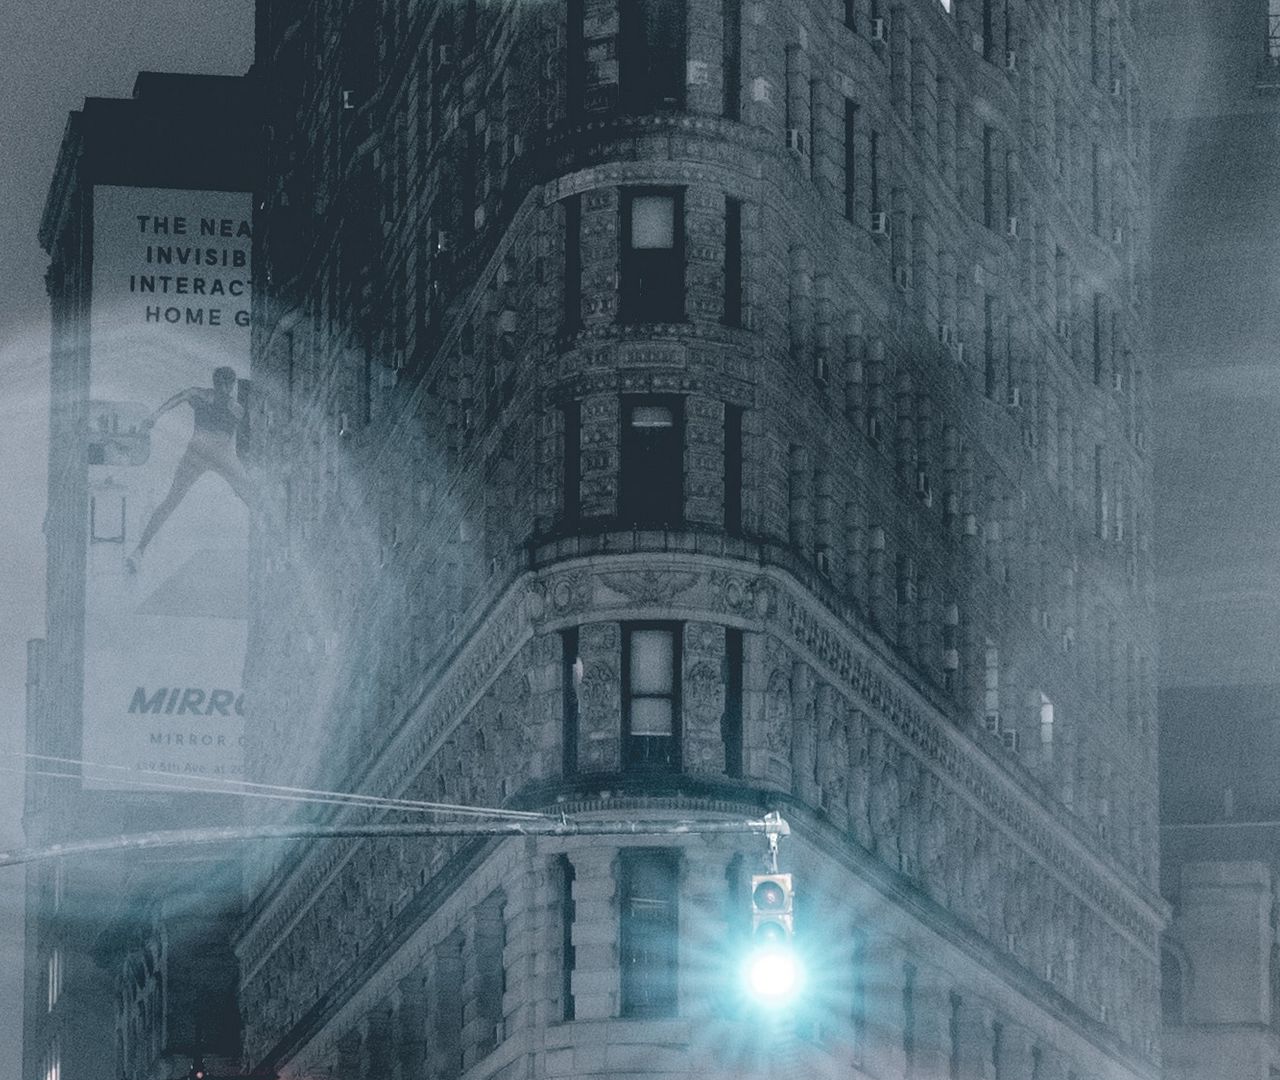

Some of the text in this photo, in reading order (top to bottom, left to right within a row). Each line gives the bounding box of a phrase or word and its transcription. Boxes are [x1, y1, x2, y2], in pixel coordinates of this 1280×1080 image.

[137, 215, 252, 238] THE NEA
[146, 246, 247, 267] INVISIB
[146, 306, 221, 326] HOME
